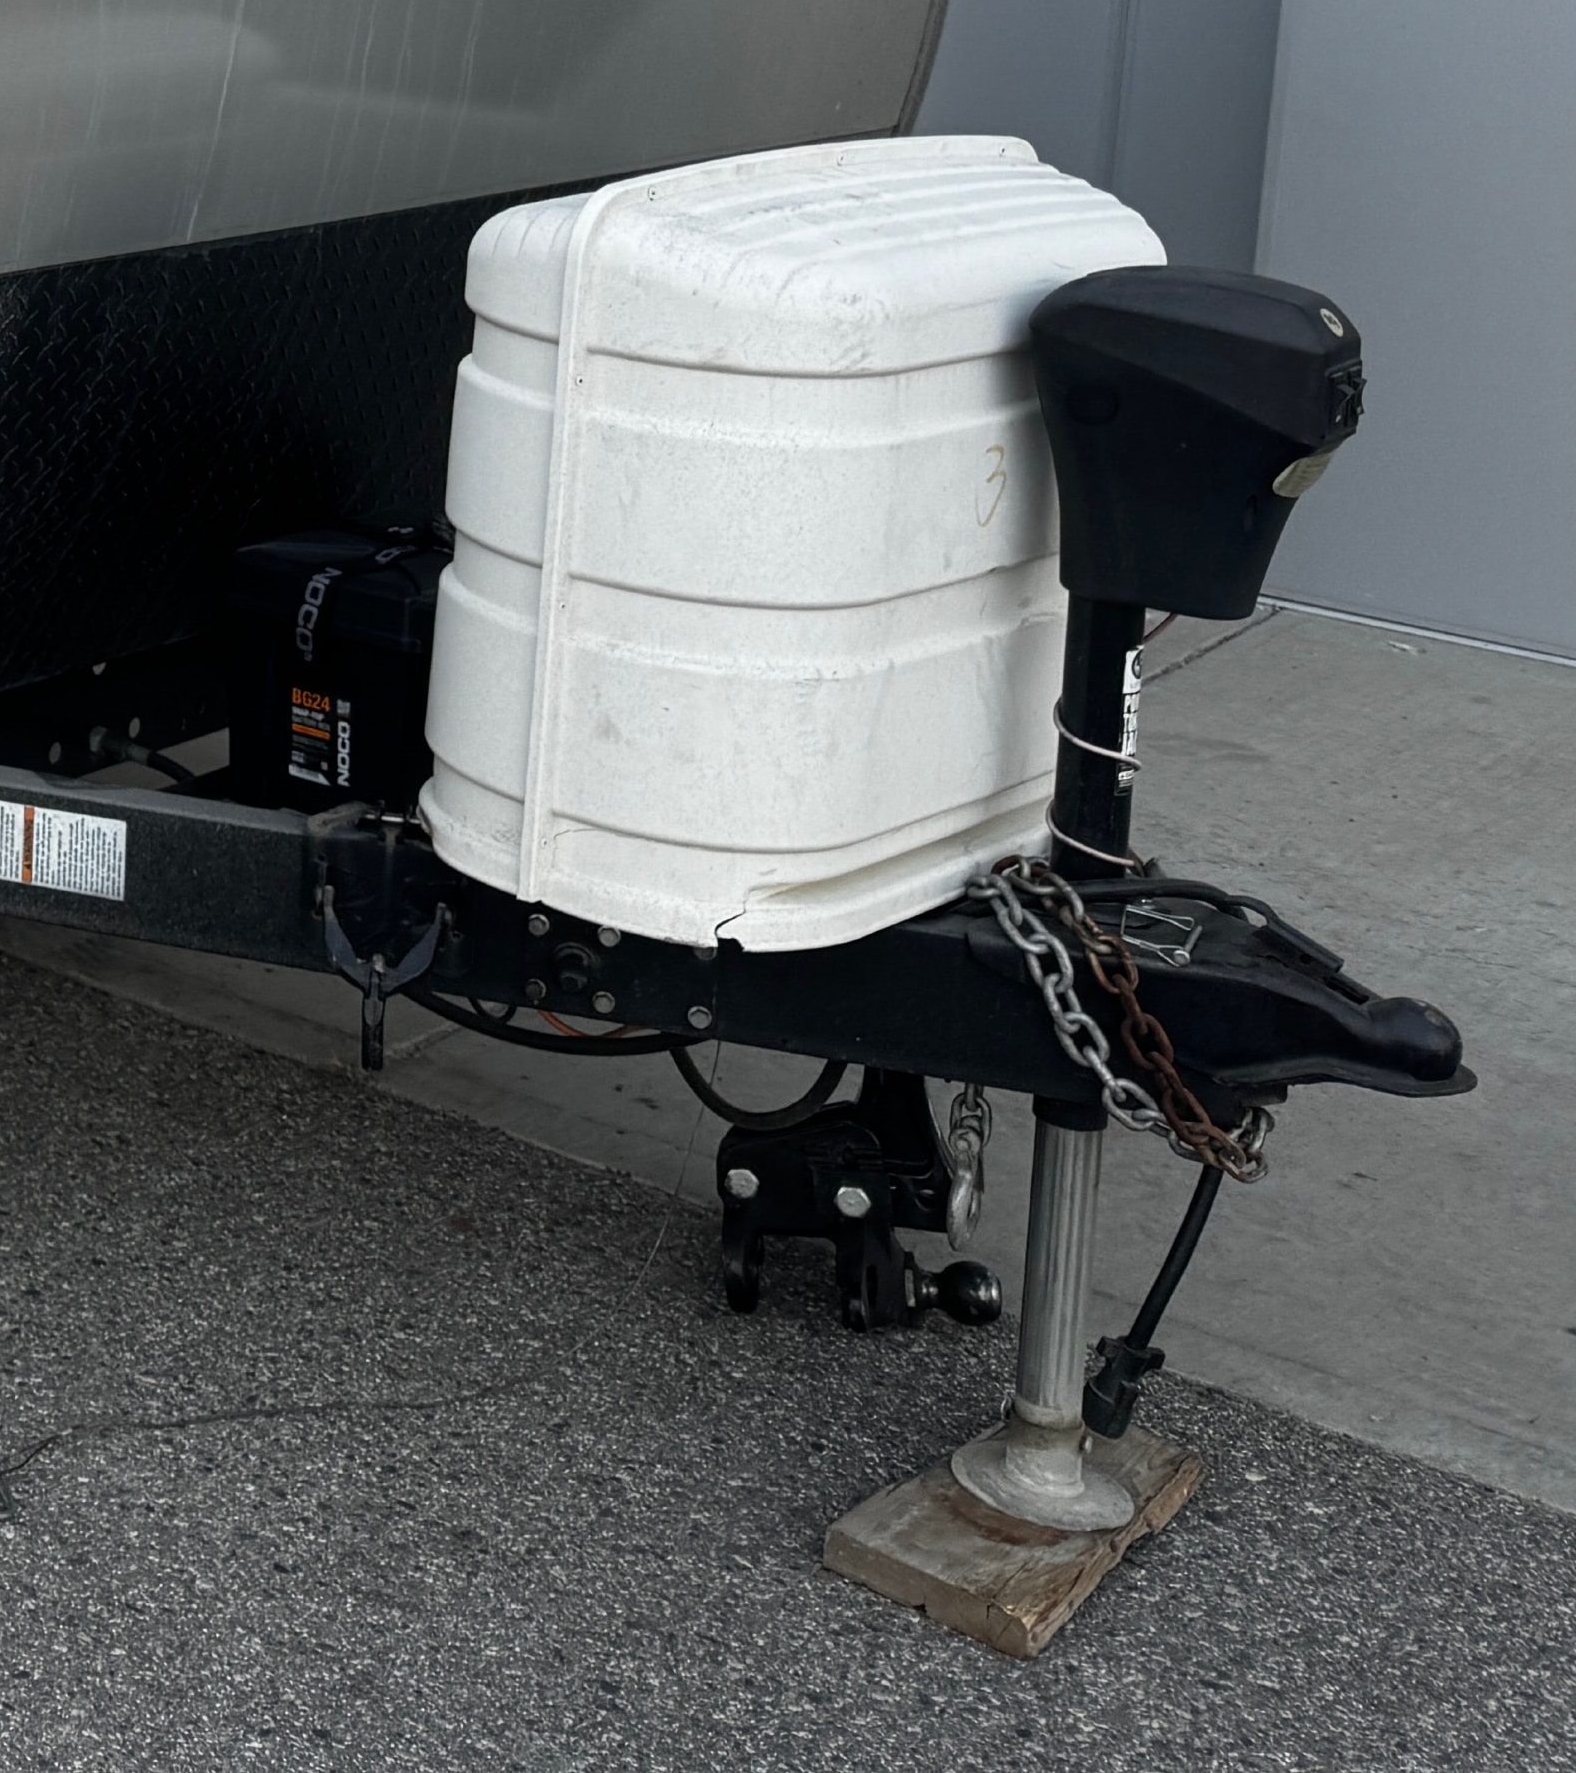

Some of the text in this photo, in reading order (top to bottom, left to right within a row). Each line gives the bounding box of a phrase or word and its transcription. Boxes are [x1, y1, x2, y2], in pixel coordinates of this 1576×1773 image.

[295, 566, 344, 653] NOCO
[291, 687, 332, 713] BG24
[336, 721, 352, 787] NOCO
